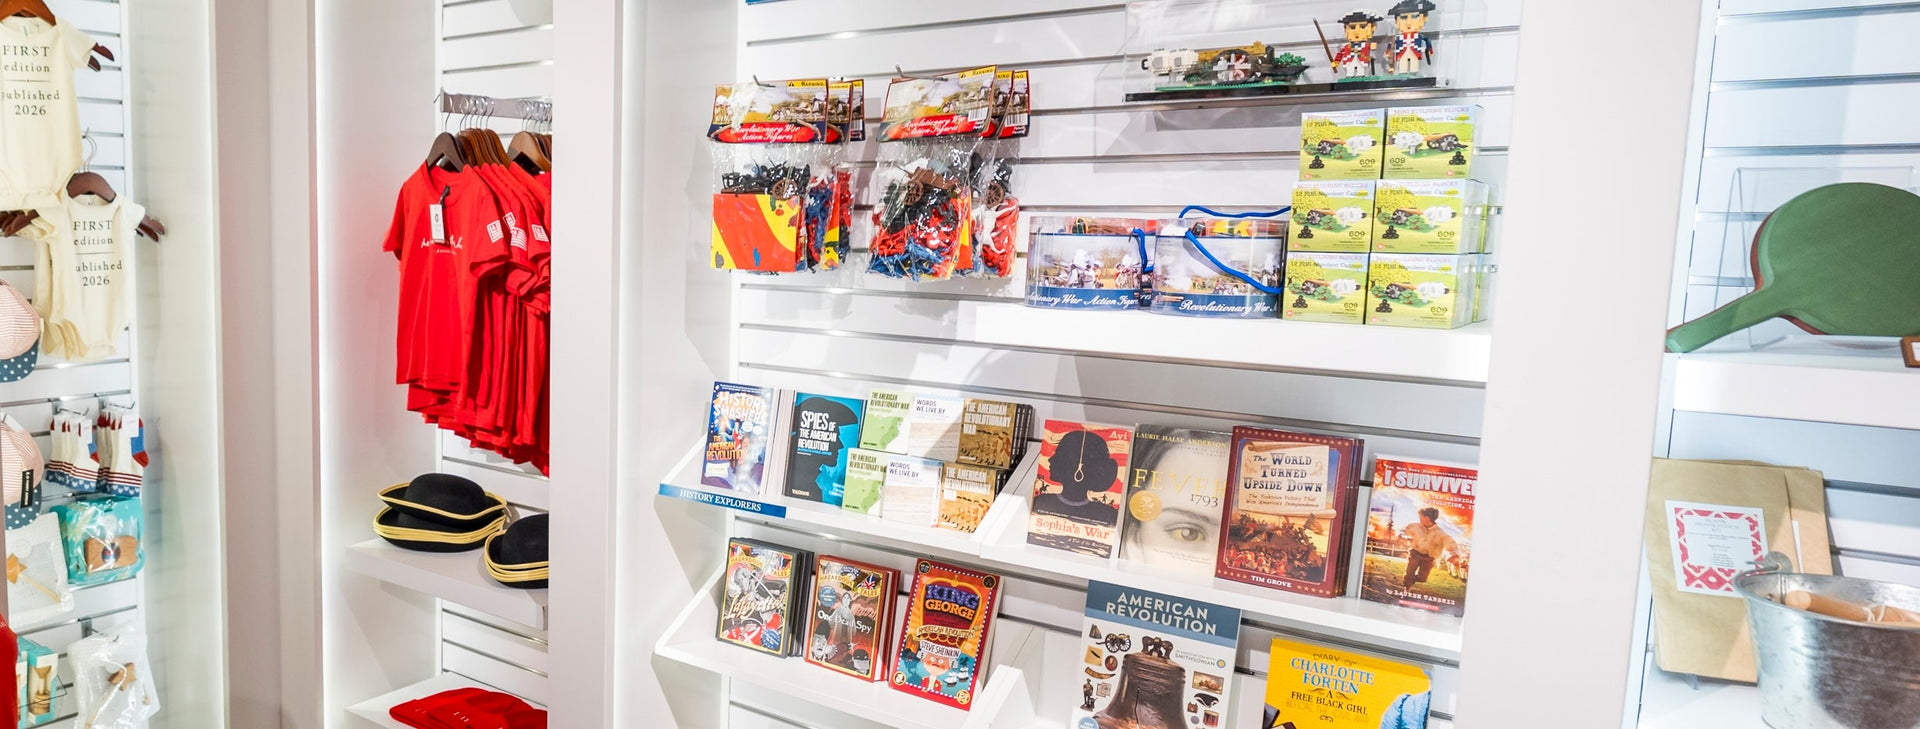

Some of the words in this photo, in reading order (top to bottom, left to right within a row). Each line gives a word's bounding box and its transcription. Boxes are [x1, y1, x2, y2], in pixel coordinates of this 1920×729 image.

[3, 45, 50, 57] FIRST
[4, 62, 50, 72] edition
[15, 105, 46, 115] 2026
[73, 220, 113, 231] FIRST
[73, 236, 113, 246] edition
[76, 260, 122, 272] ublished
[83, 276, 110, 286] 2026
[1061, 293, 1083, 304] War
[1083, 295, 1118, 306] Action
[1179, 300, 1252, 317] Revolutionary
[1253, 302, 1270, 312] War
[879, 393, 898, 401] AMERICAN
[917, 399, 936, 407] WORDS
[870, 400, 900, 409] REVOLUTIONARY
[800, 411, 829, 430] SPIES
[829, 422, 836, 431] OF
[800, 428, 810, 438] THE
[810, 430, 837, 442] AMERICAN
[1109, 431, 1128, 440] Avi
[1136, 432, 1159, 441] LAURIE
[1188, 438, 1229, 449] ANDERSON
[798, 438, 829, 451] REVOLUTION
[706, 450, 747, 461] REVOLUTIO
[1270, 453, 1312, 465] WORLD
[890, 462, 910, 470] WORDS
[1260, 465, 1307, 478] TURNED
[1384, 469, 1392, 486] I
[1243, 477, 1282, 490] UPSIDE
[1287, 479, 1323, 492] DOWN
[680, 488, 714, 502] HISTORY
[714, 496, 762, 512] EXPLORERS
[1190, 494, 1219, 508] 1793
[1036, 518, 1080, 534] Sophia's
[1084, 526, 1110, 539] War
[1251, 575, 1266, 584] TIM
[1266, 578, 1292, 588] GROVE
[926, 584, 980, 609] KING
[925, 599, 975, 620] GEORGE
[1117, 592, 1208, 621] AMERICAN
[1106, 602, 1217, 636] REVOLUTION
[856, 620, 872, 633] Spy
[918, 626, 944, 635] AMERICAN
[921, 641, 936, 653] STEVE
[936, 644, 960, 657] SHEINKIN
[1312, 653, 1340, 662] DIARY
[1291, 657, 1375, 685] CHARLOTTE
[1302, 672, 1359, 694] FORTEN
[1326, 690, 1333, 698] A
[1291, 691, 1313, 702] FREE
[1316, 696, 1344, 709] BLACK
[1346, 703, 1368, 715] GIRL
